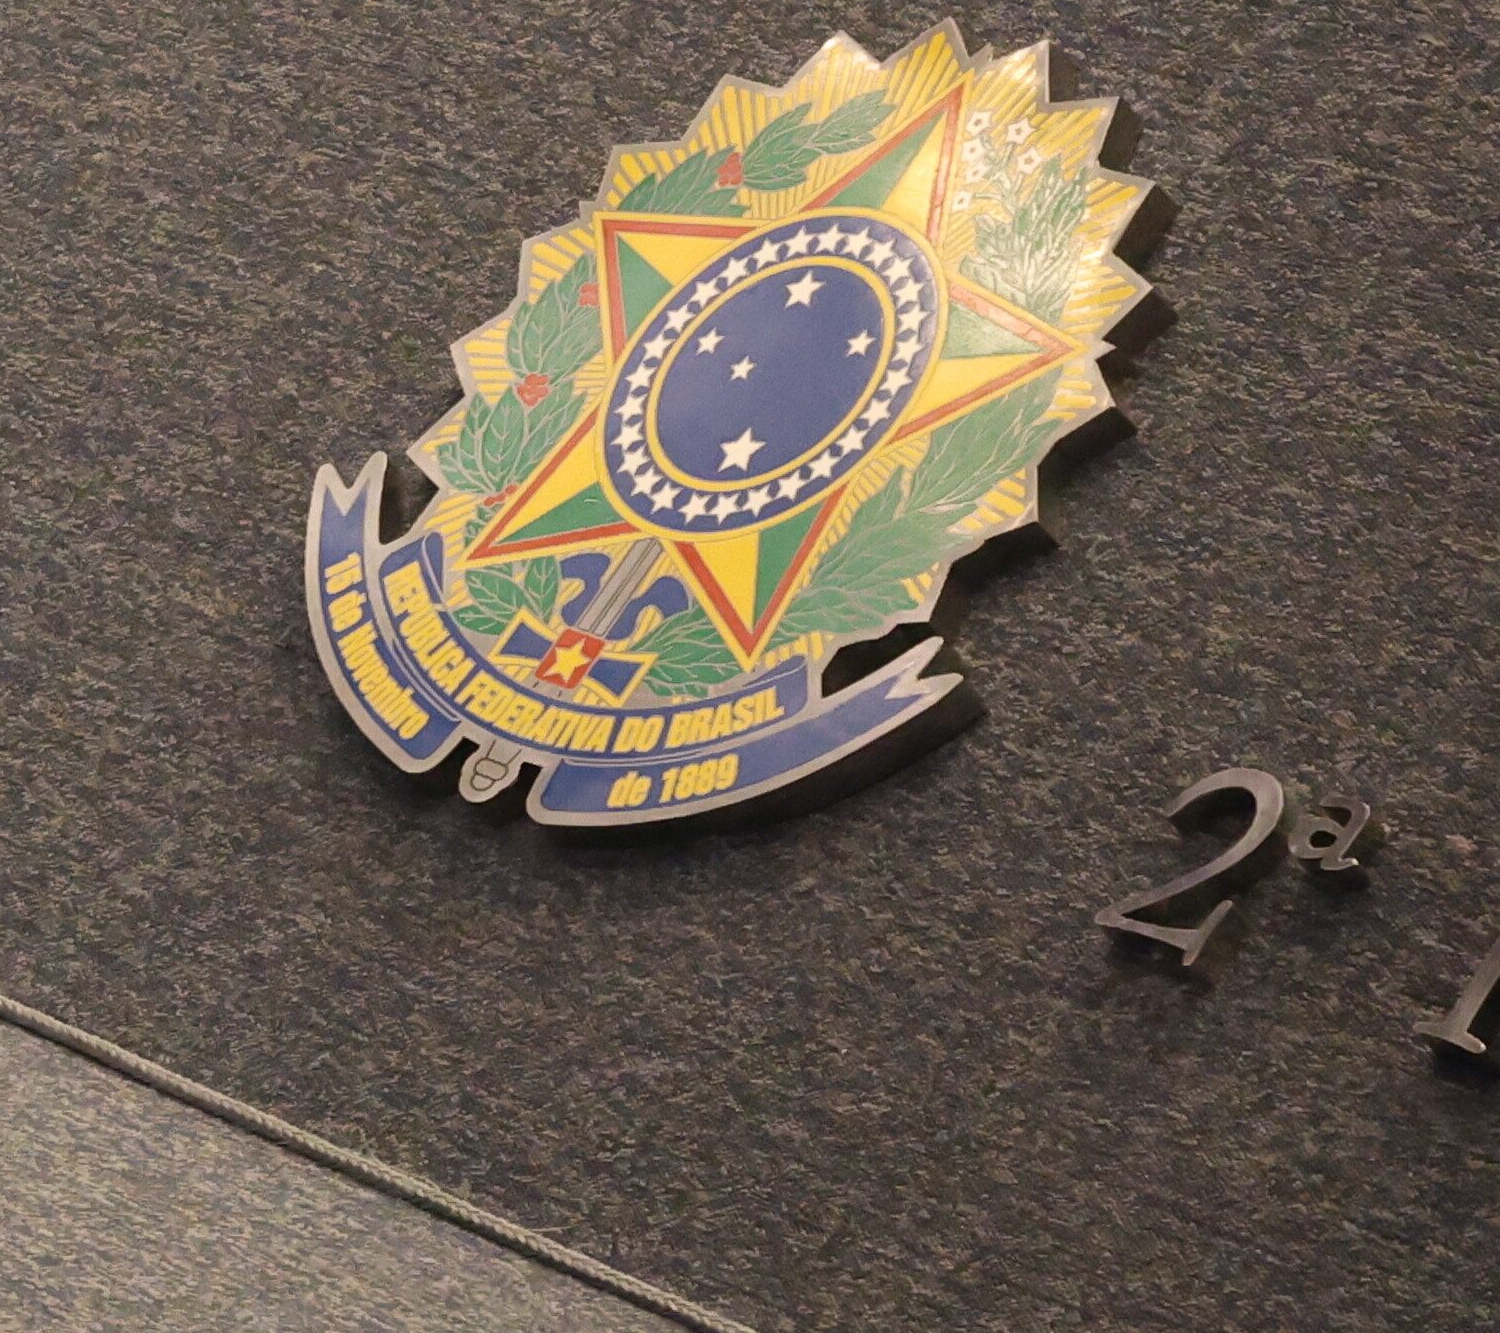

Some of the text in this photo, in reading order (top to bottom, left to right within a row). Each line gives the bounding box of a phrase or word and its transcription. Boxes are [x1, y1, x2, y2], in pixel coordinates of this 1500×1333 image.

[323, 552, 430, 740] 15 de Novembro
[453, 669, 617, 752] FEDERATIVA
[611, 714, 665, 754] DO
[663, 686, 786, 750] BRASIL
[606, 753, 740, 808] de 1889
